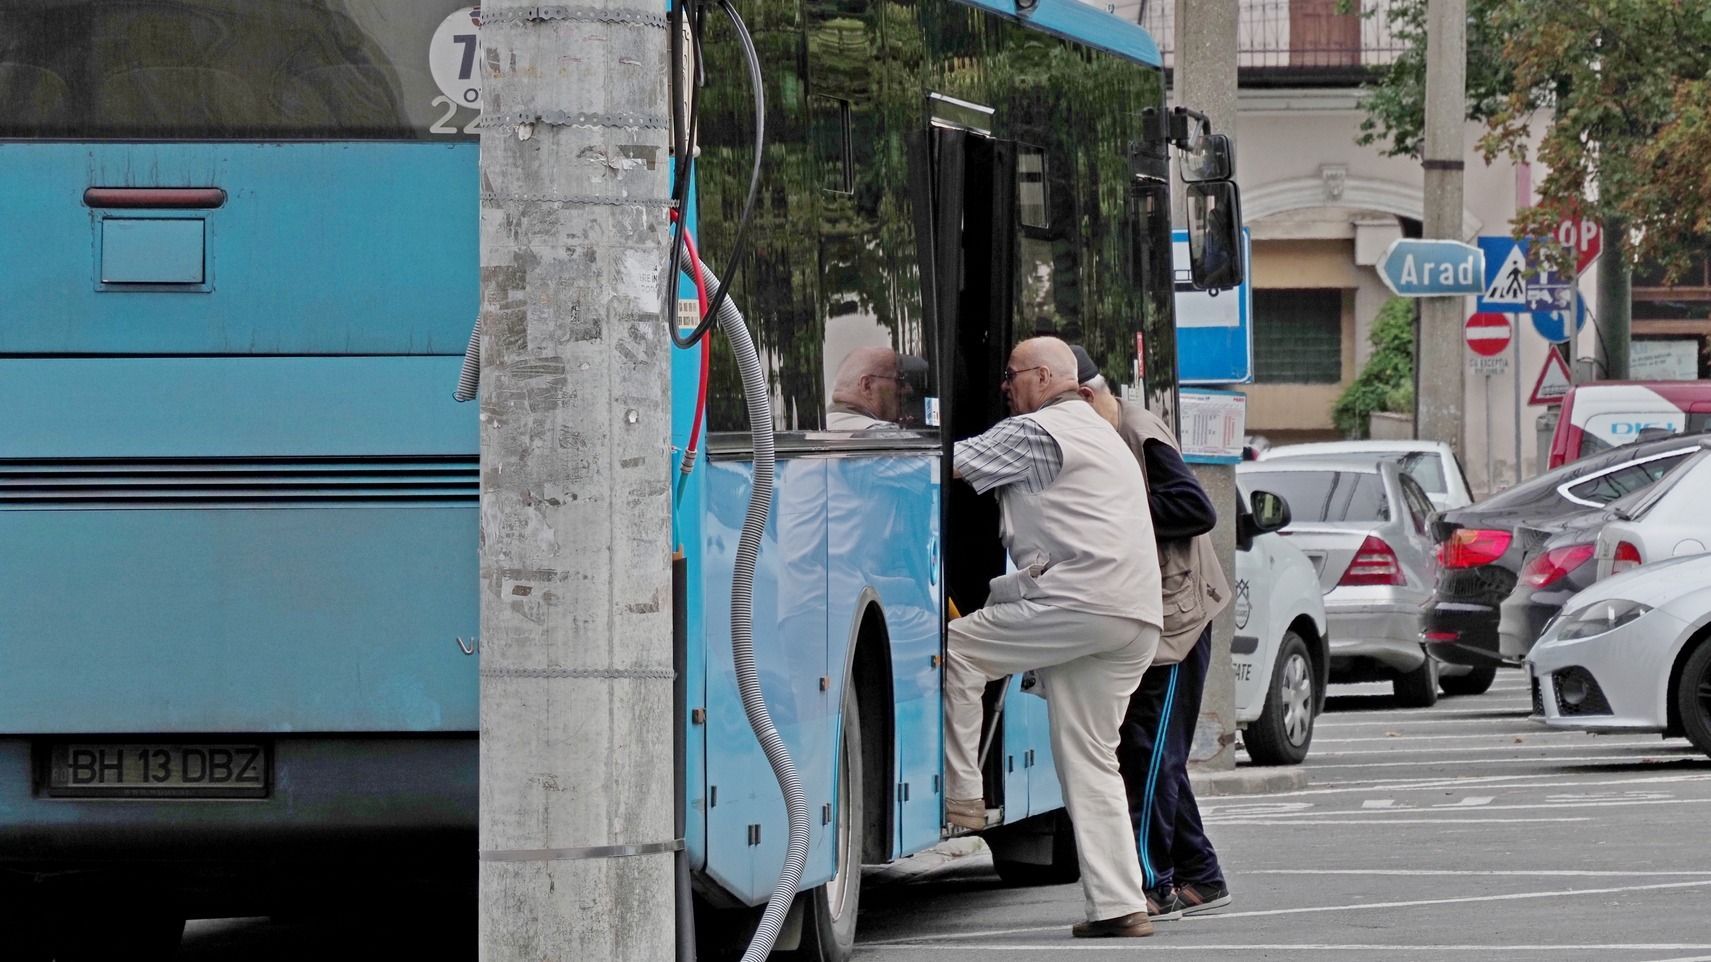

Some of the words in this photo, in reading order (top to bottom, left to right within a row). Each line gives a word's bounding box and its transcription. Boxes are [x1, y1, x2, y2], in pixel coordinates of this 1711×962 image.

[453, 34, 481, 80] 7
[1559, 216, 1598, 252] OP
[1401, 254, 1474, 285] Arad
[73, 749, 123, 784] BH
[138, 749, 171, 783] 13
[181, 749, 260, 783] DBZ
